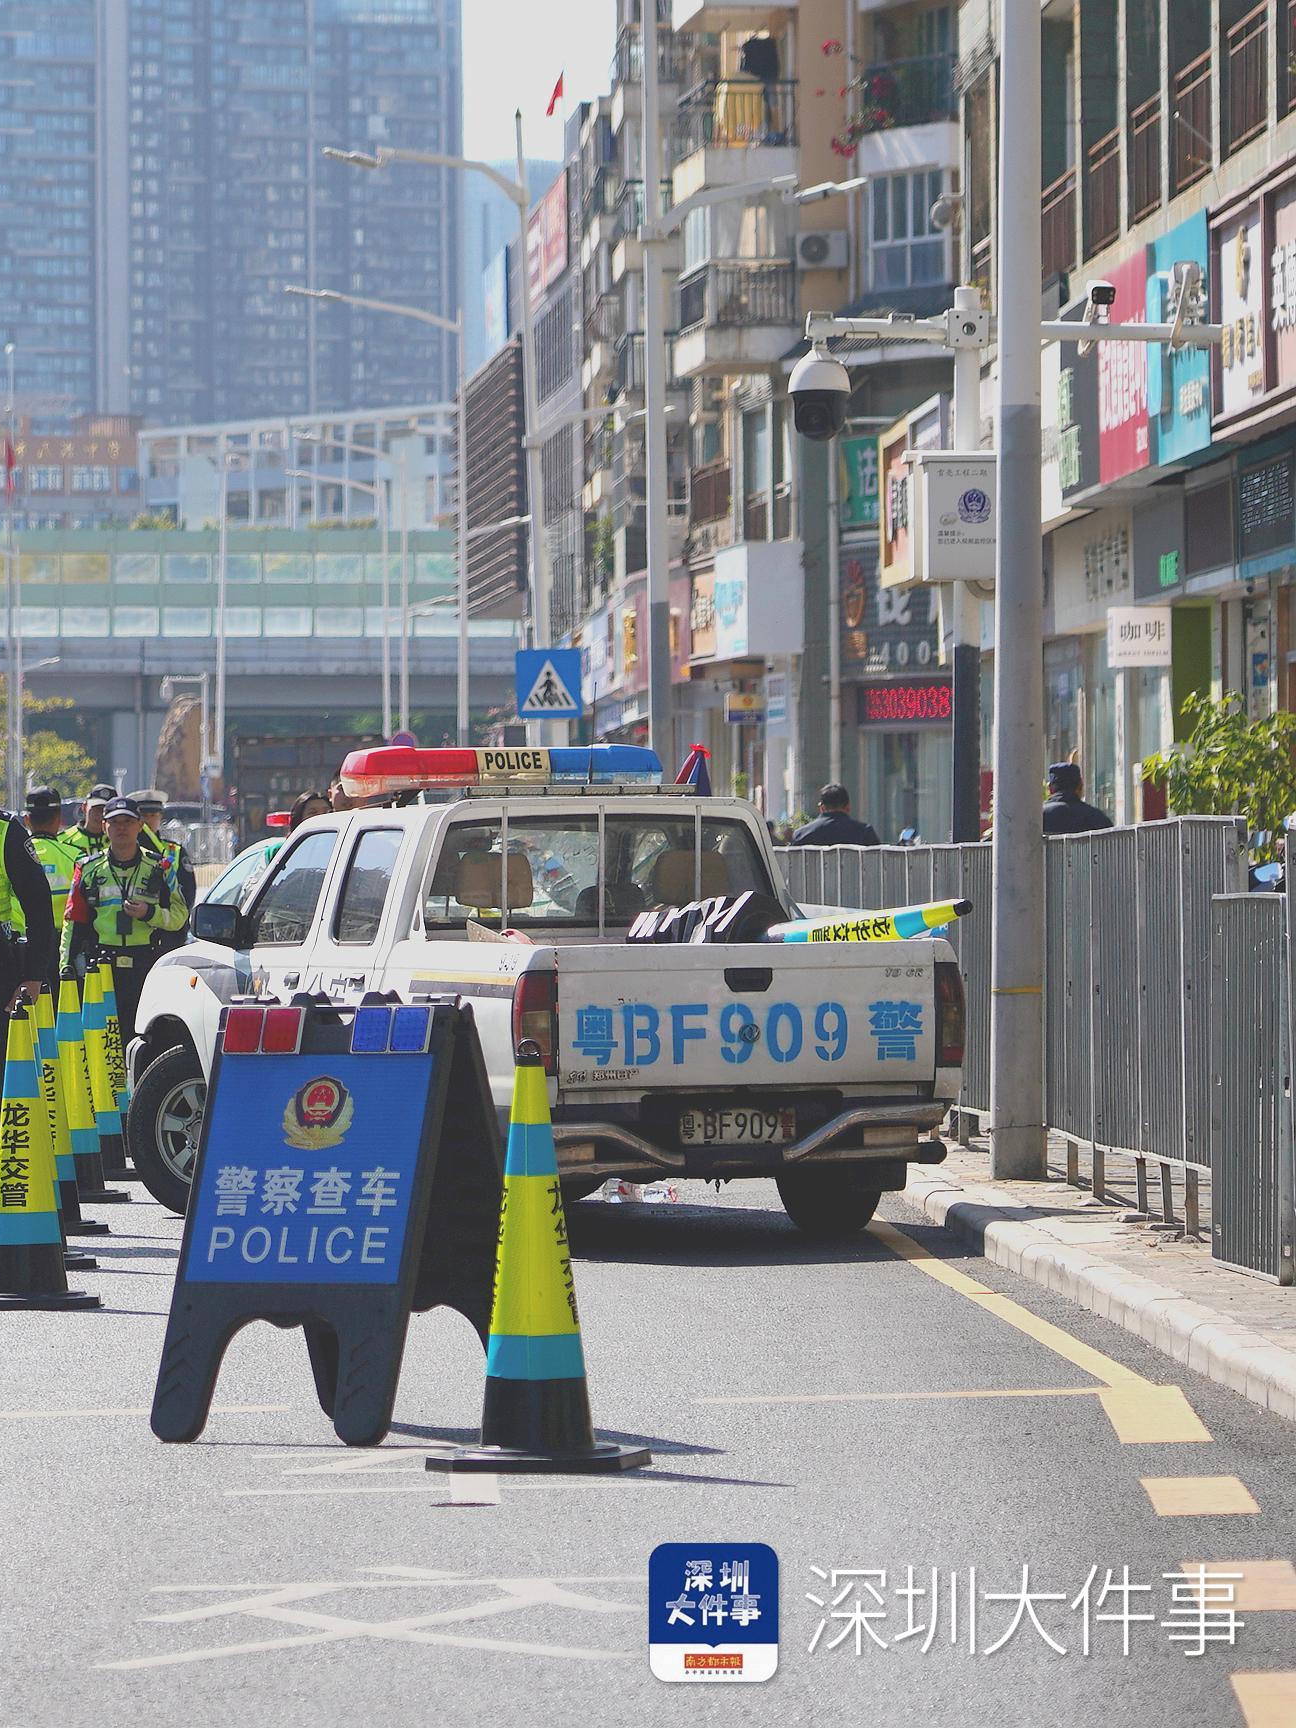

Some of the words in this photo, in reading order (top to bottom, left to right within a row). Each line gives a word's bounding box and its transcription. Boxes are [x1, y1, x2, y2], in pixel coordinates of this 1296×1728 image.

[1120, 619, 1166, 642] 咖啡
[484, 751, 543, 770] POLICE
[0, 1101, 32, 1210] 龙华交管
[214, 1165, 402, 1217] 警察查车
[206, 1225, 392, 1265] POLICE
